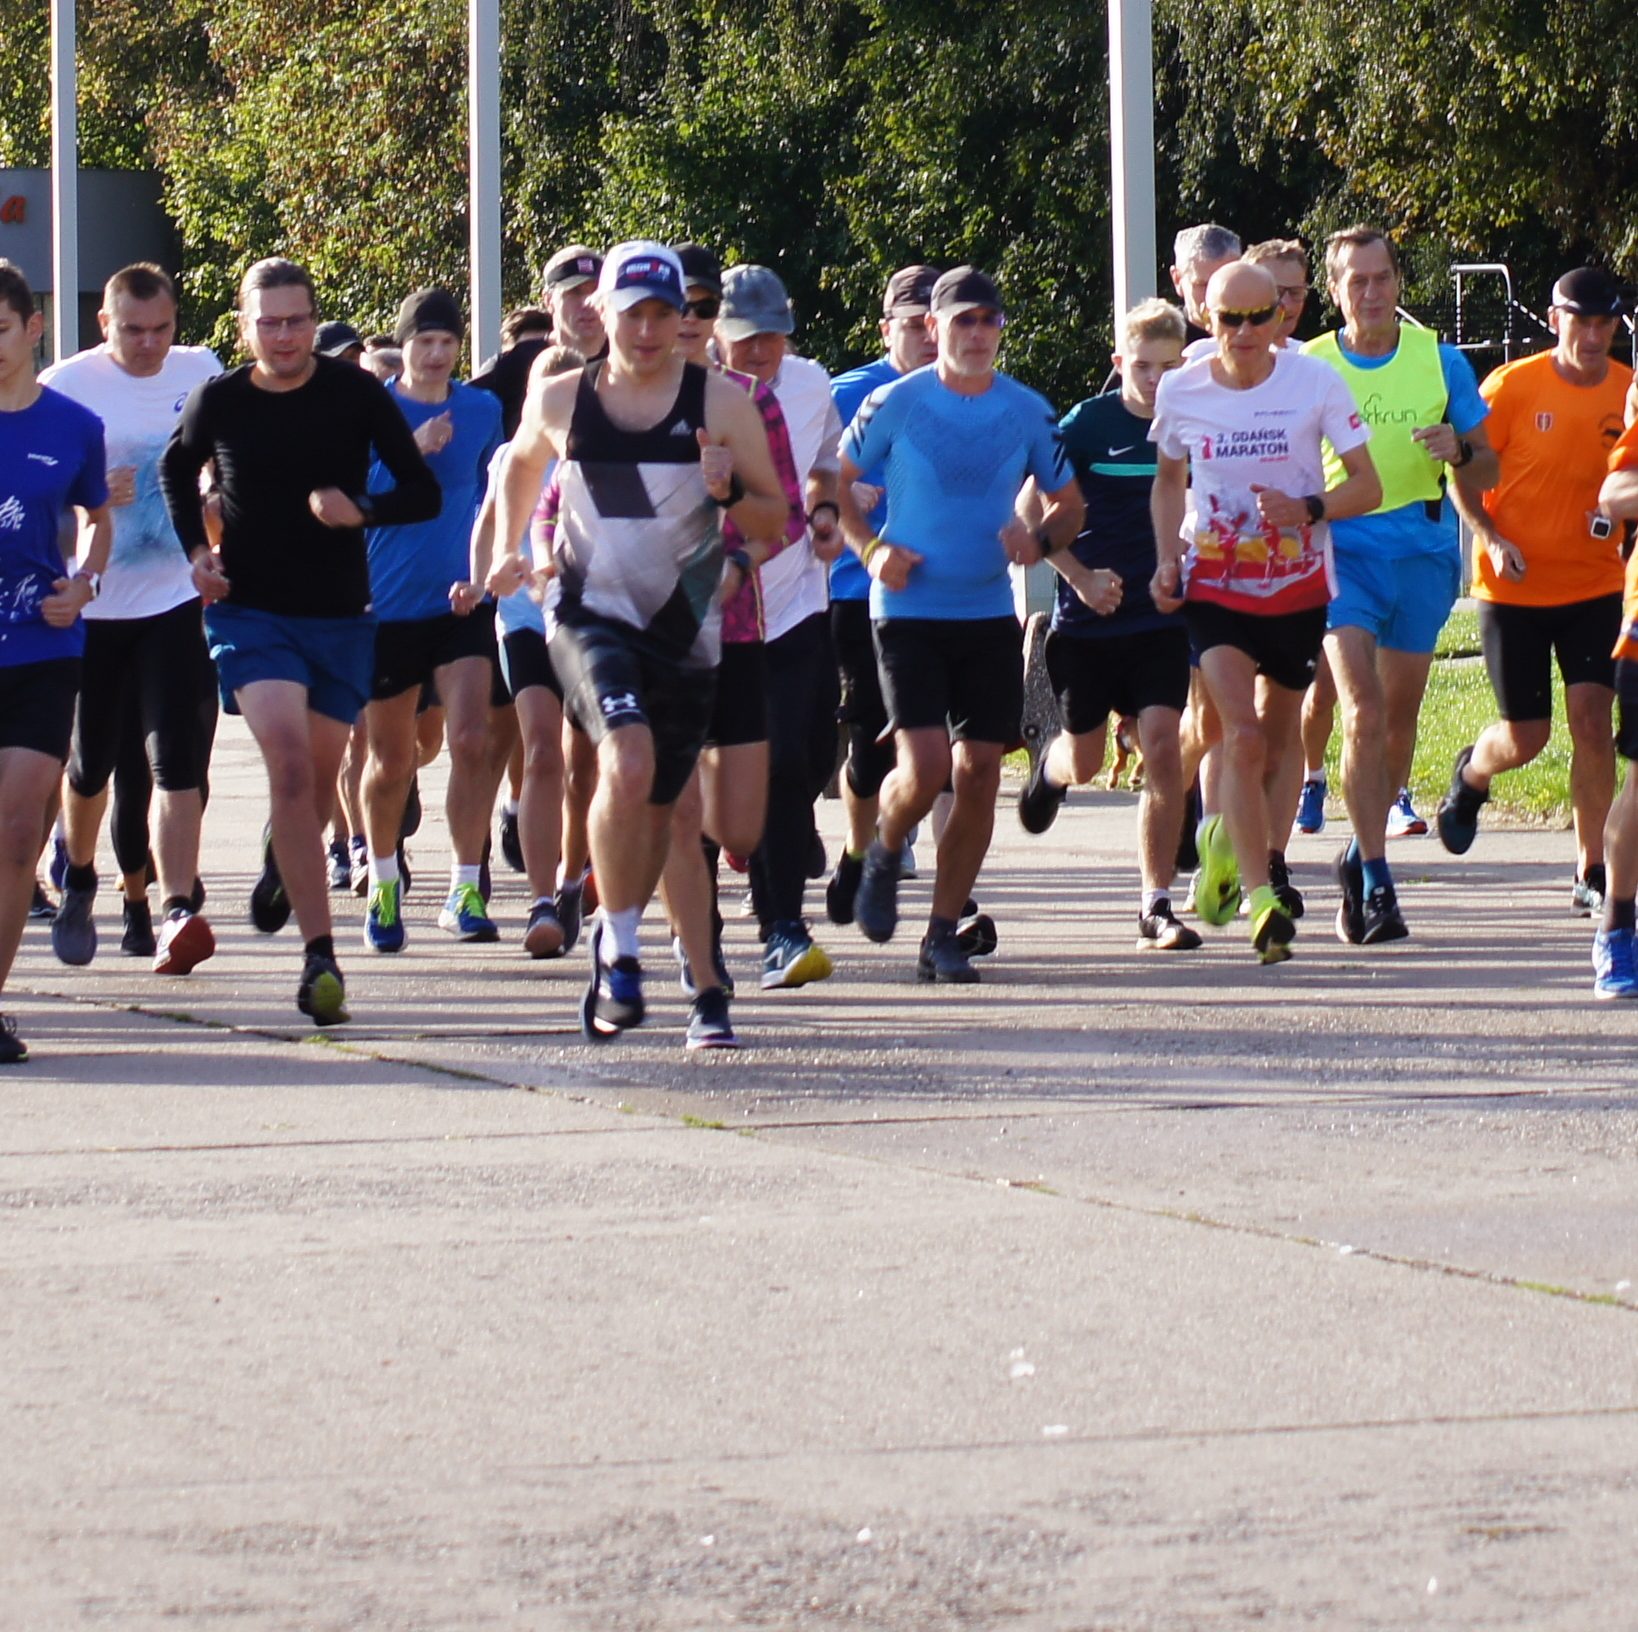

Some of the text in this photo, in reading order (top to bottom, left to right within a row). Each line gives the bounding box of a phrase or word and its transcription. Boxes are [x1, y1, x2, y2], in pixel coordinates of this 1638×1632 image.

[1359, 404, 1418, 425] rkrun
[1231, 428, 1287, 443] GDAŃSK
[1216, 442, 1289, 458] MARATON
